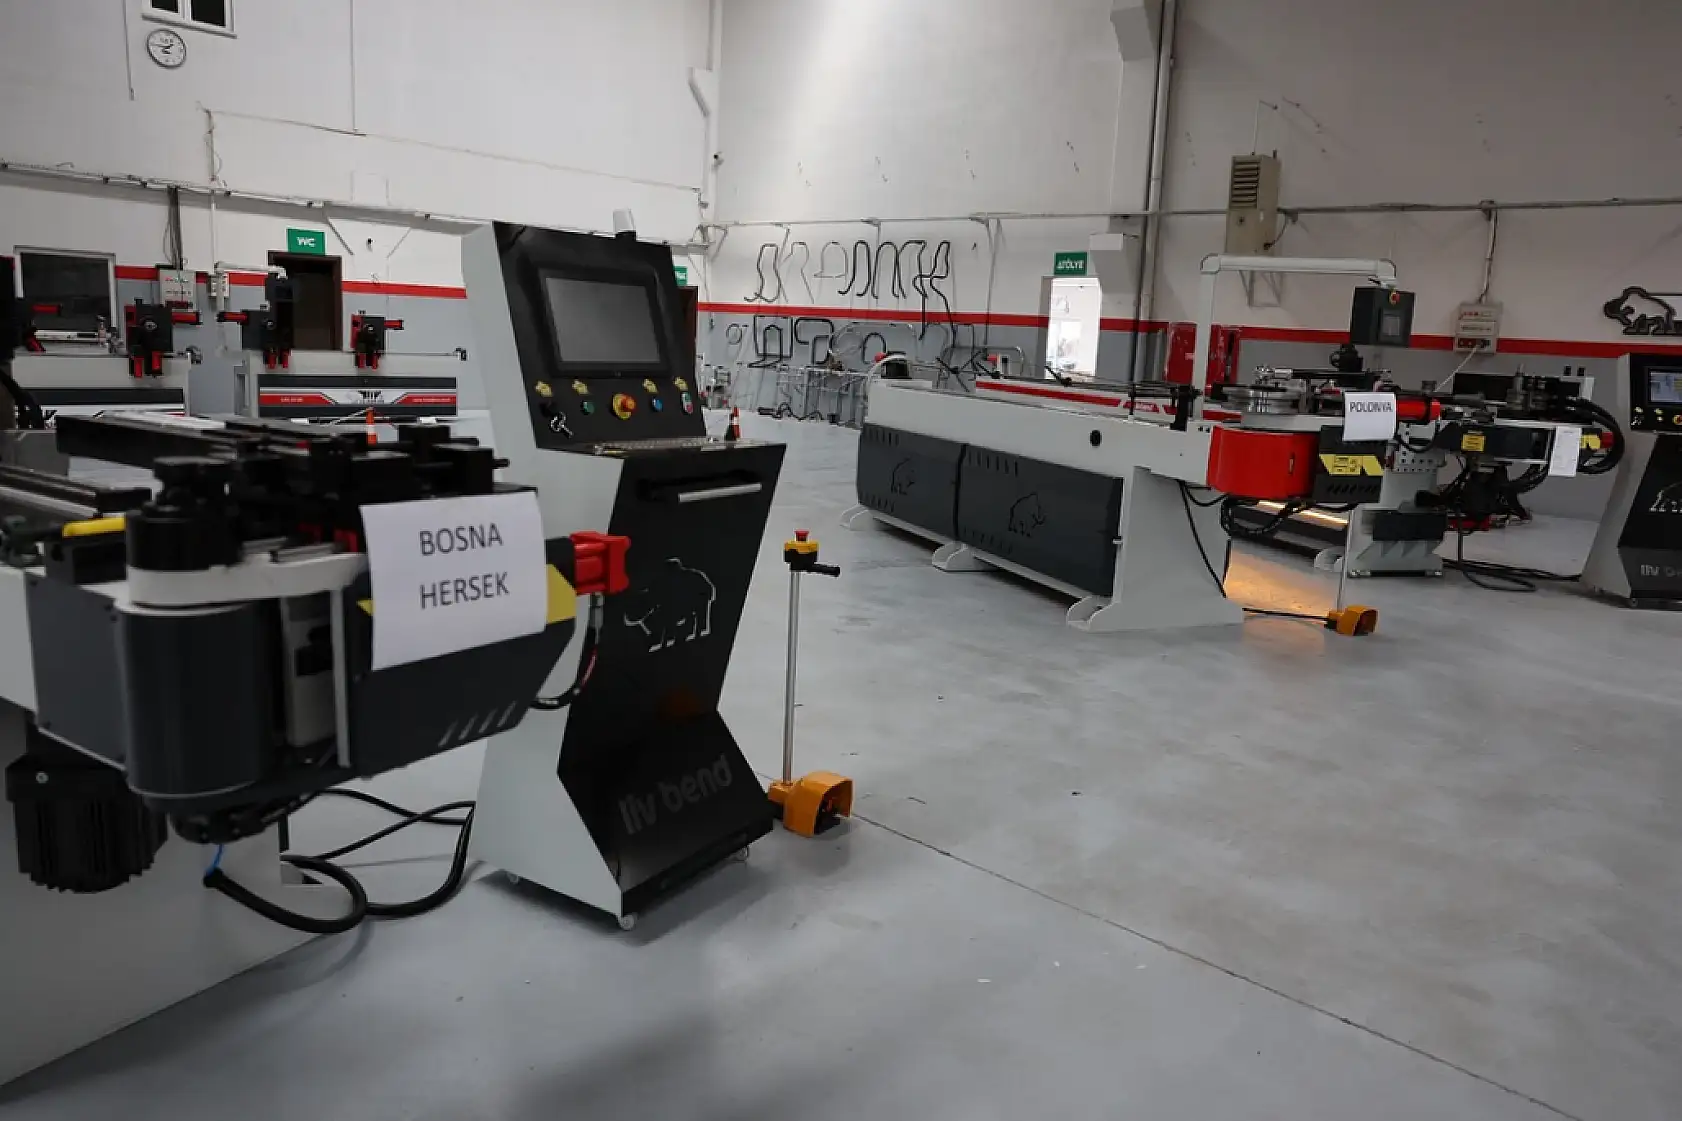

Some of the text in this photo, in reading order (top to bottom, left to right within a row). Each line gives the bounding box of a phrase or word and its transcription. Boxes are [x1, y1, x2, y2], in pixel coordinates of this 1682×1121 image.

[296, 236, 316, 248] WC
[1349, 401, 1393, 413] POLONYA
[419, 522, 504, 556] BOSNA
[419, 571, 510, 610] HERSEK
[657, 752, 732, 813] bend
